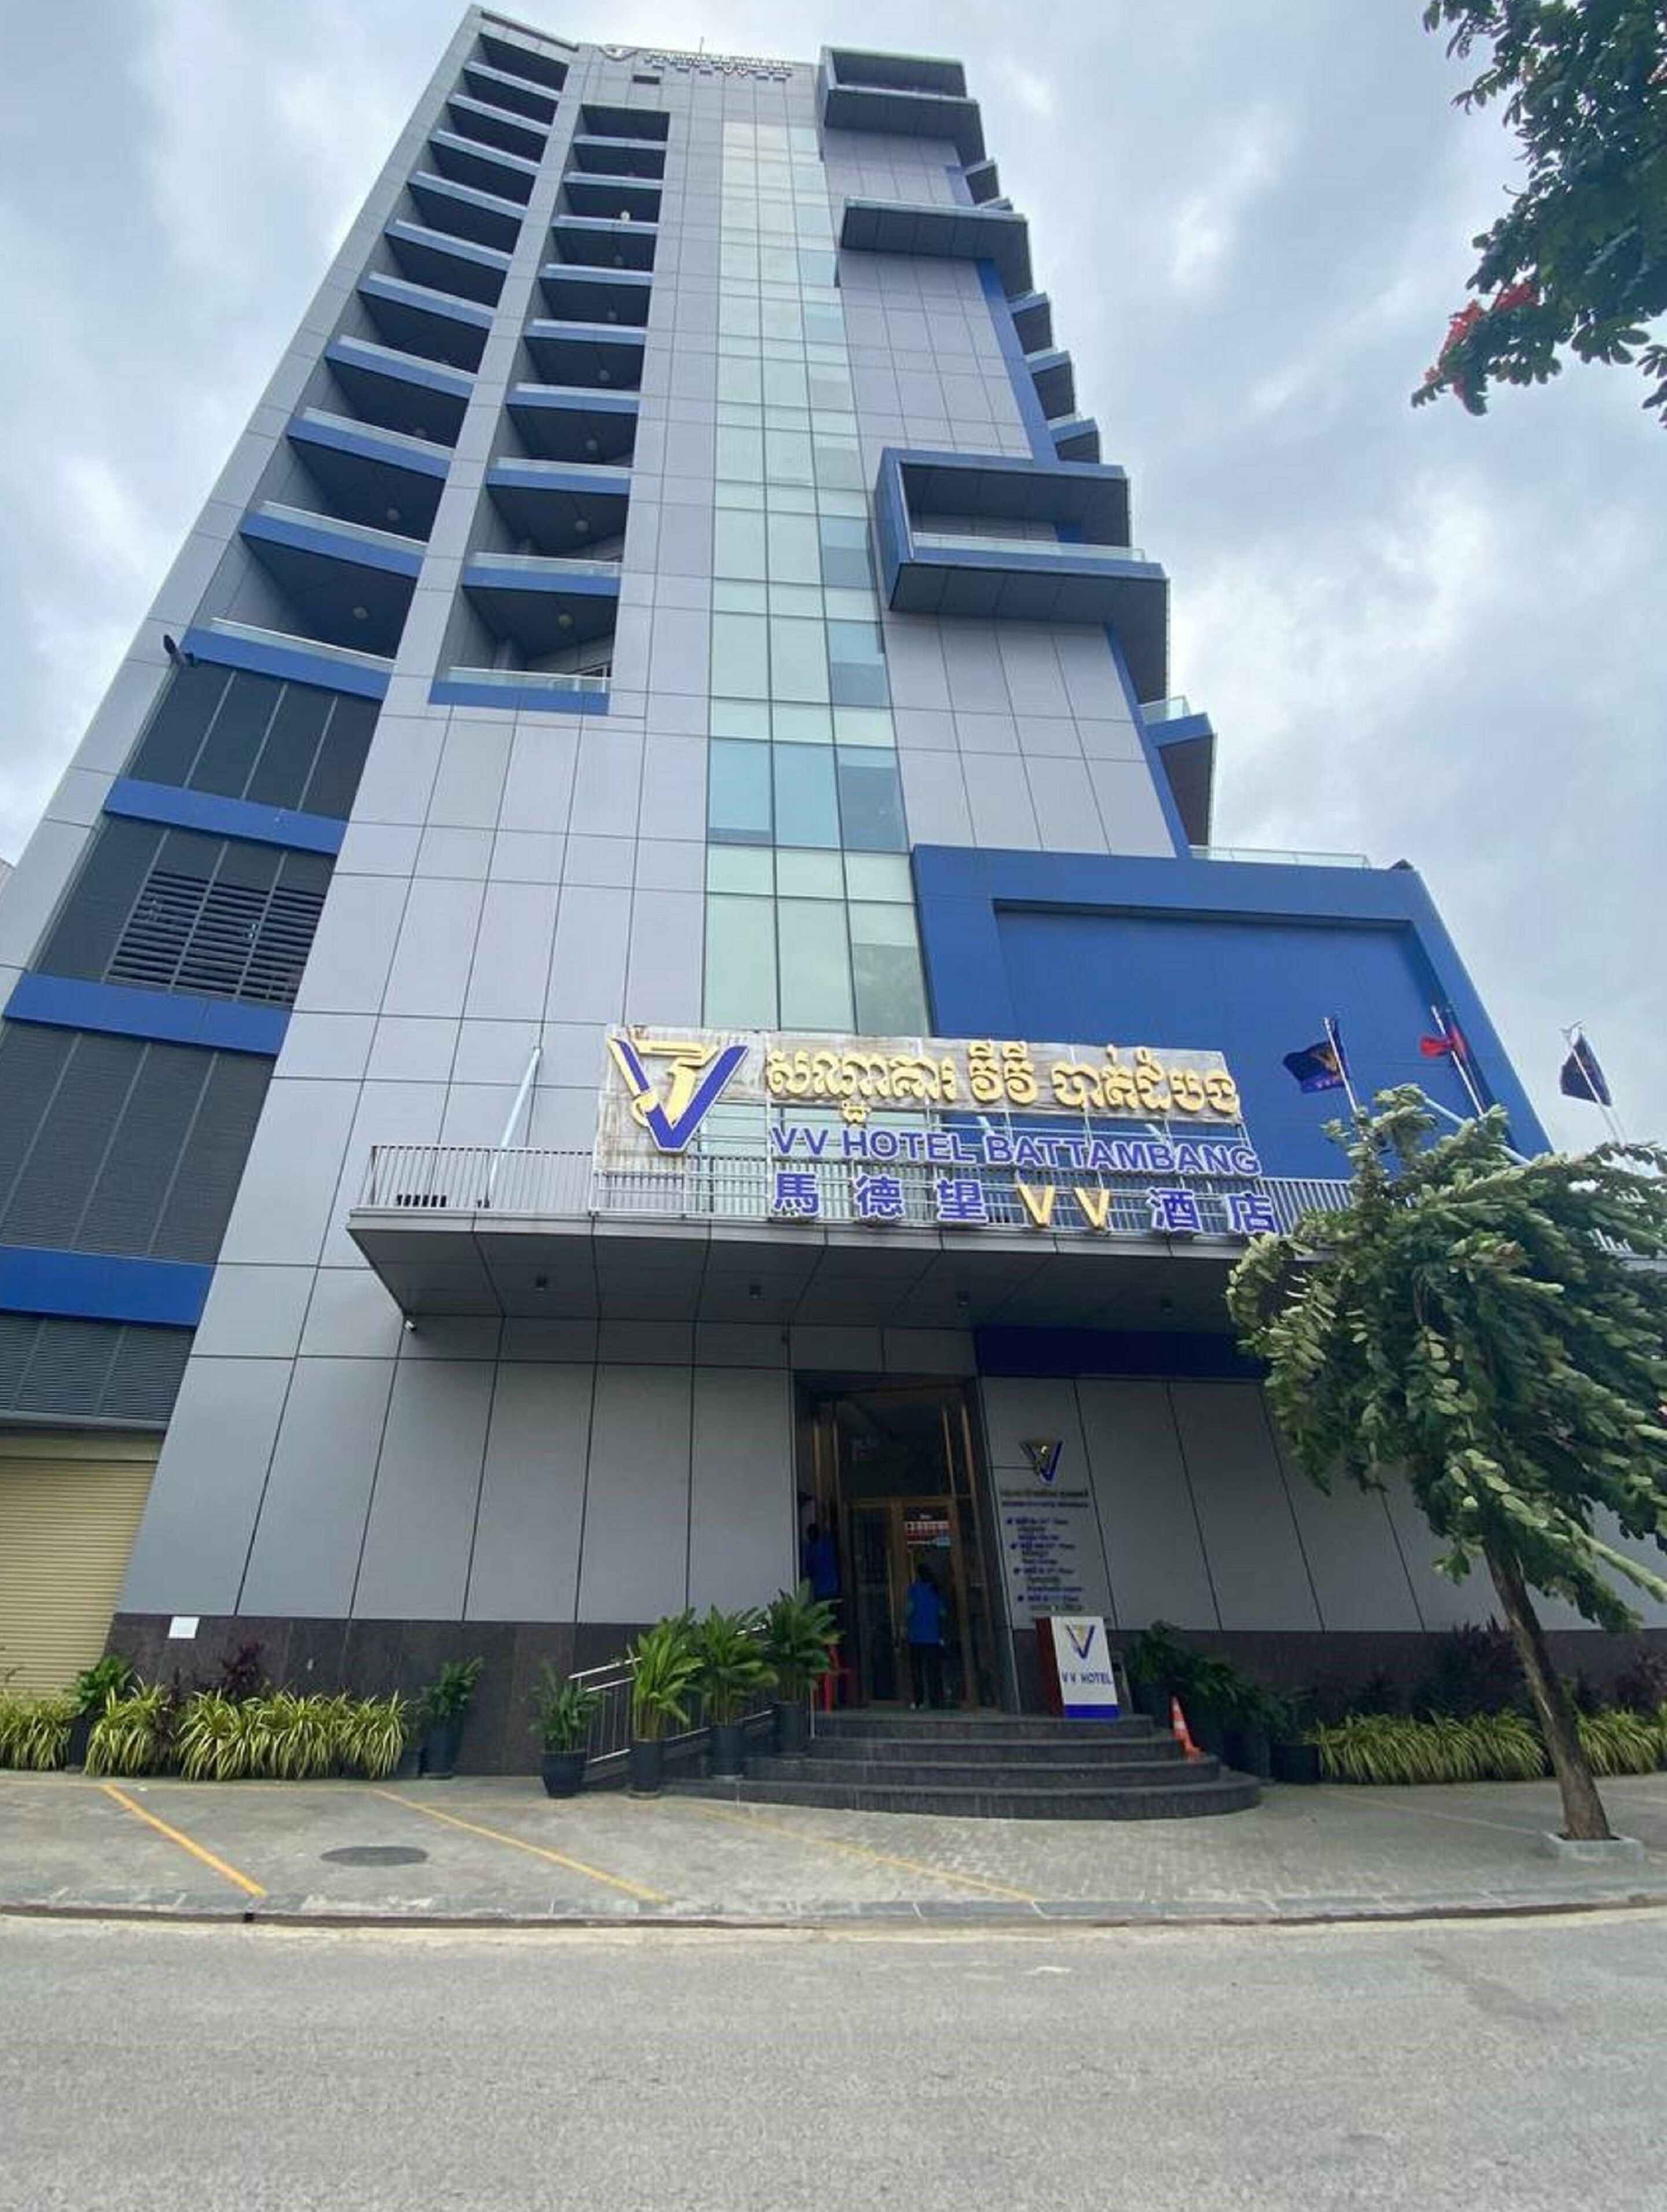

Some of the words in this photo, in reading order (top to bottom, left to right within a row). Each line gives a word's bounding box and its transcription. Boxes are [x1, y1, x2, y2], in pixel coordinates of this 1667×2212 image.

[842, 1129, 977, 1164] HOTEL
[984, 1134, 1262, 1175] BATTAMBANG
[1081, 1672, 1113, 1685] HOTEL
